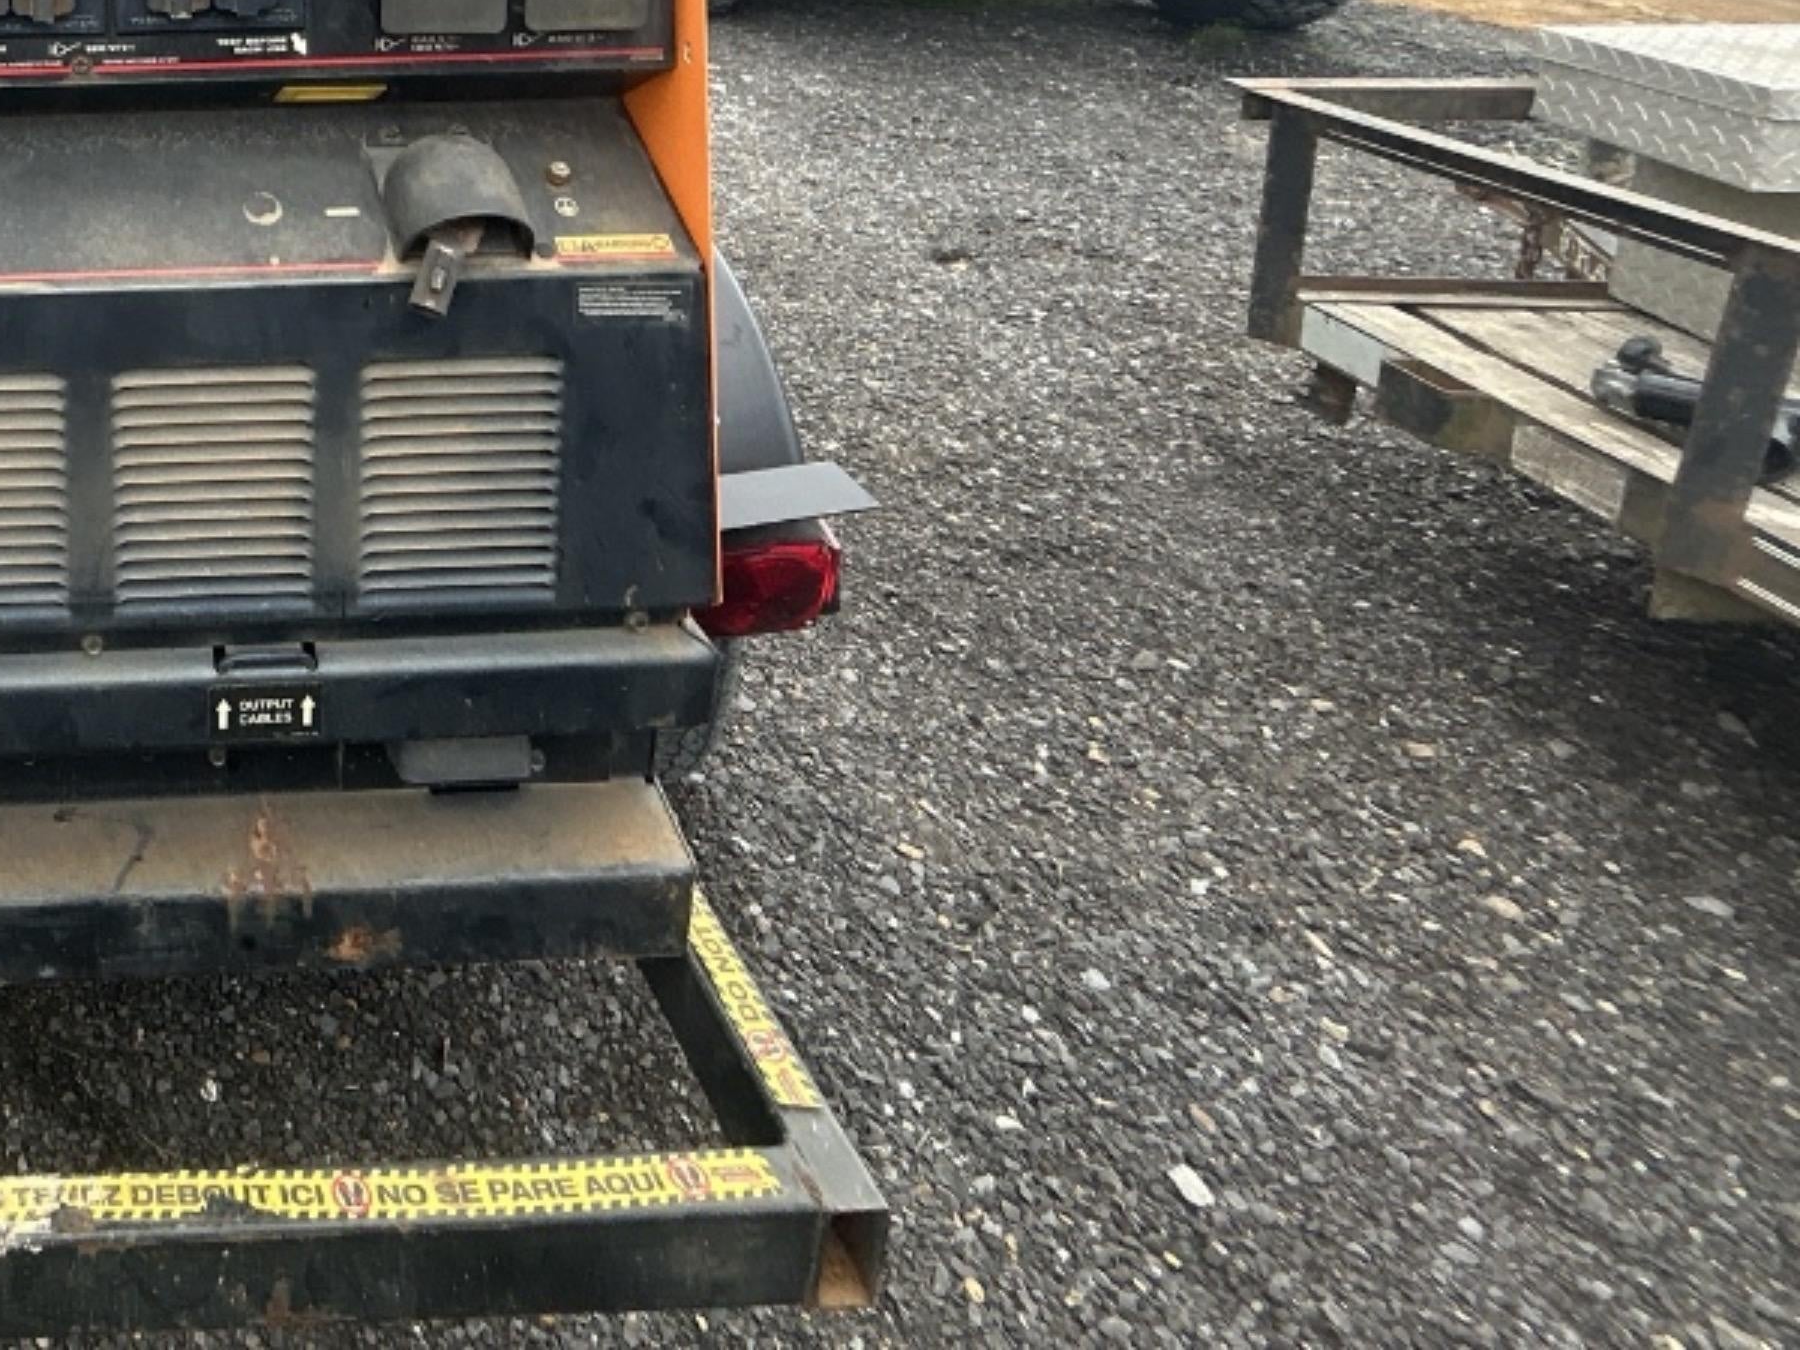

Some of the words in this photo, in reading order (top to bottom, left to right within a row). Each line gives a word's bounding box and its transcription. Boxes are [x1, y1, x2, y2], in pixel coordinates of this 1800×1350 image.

[239, 698, 294, 712] OUTPUT
[239, 713, 293, 727] CABLES
[278, 1183, 325, 1206] ICI
[377, 1183, 428, 1205] NO
[437, 1179, 483, 1203] SE
[488, 1176, 580, 1203] PARE
